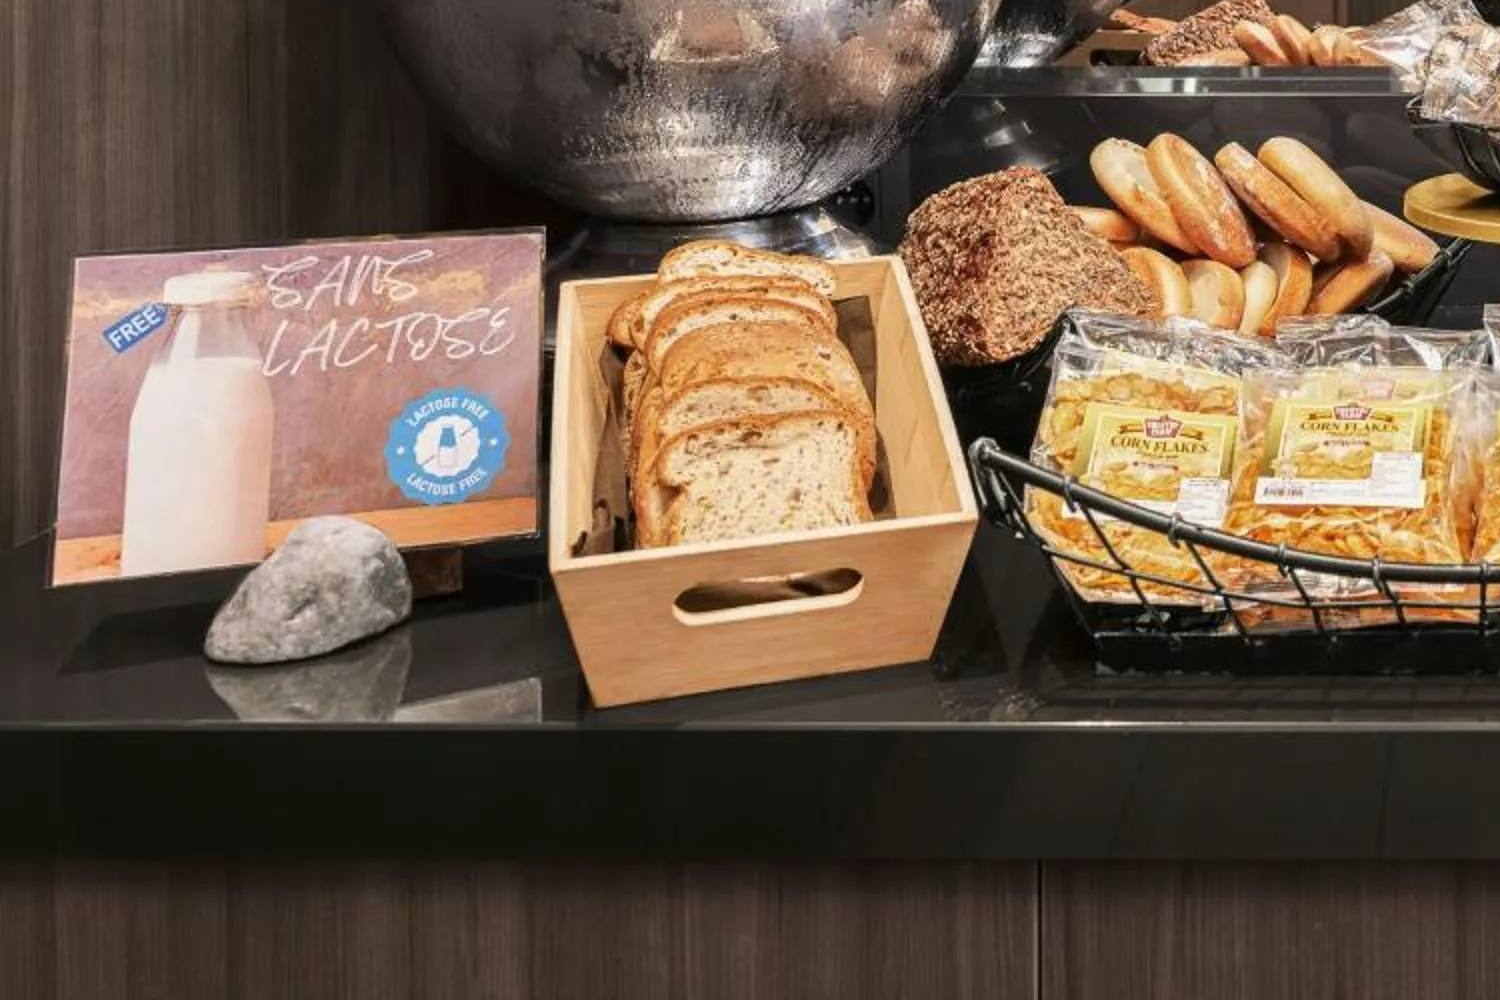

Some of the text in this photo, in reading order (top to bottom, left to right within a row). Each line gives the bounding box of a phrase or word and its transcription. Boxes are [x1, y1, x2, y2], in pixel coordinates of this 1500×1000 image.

[261, 249, 434, 311] SANS
[107, 305, 161, 350] FREE
[262, 306, 516, 377] LACTOSE
[405, 396, 491, 427] LACTOSE FREE
[1300, 421, 1400, 433] CORN FLAKES
[1110, 436, 1209, 453] CORN FLAKES
